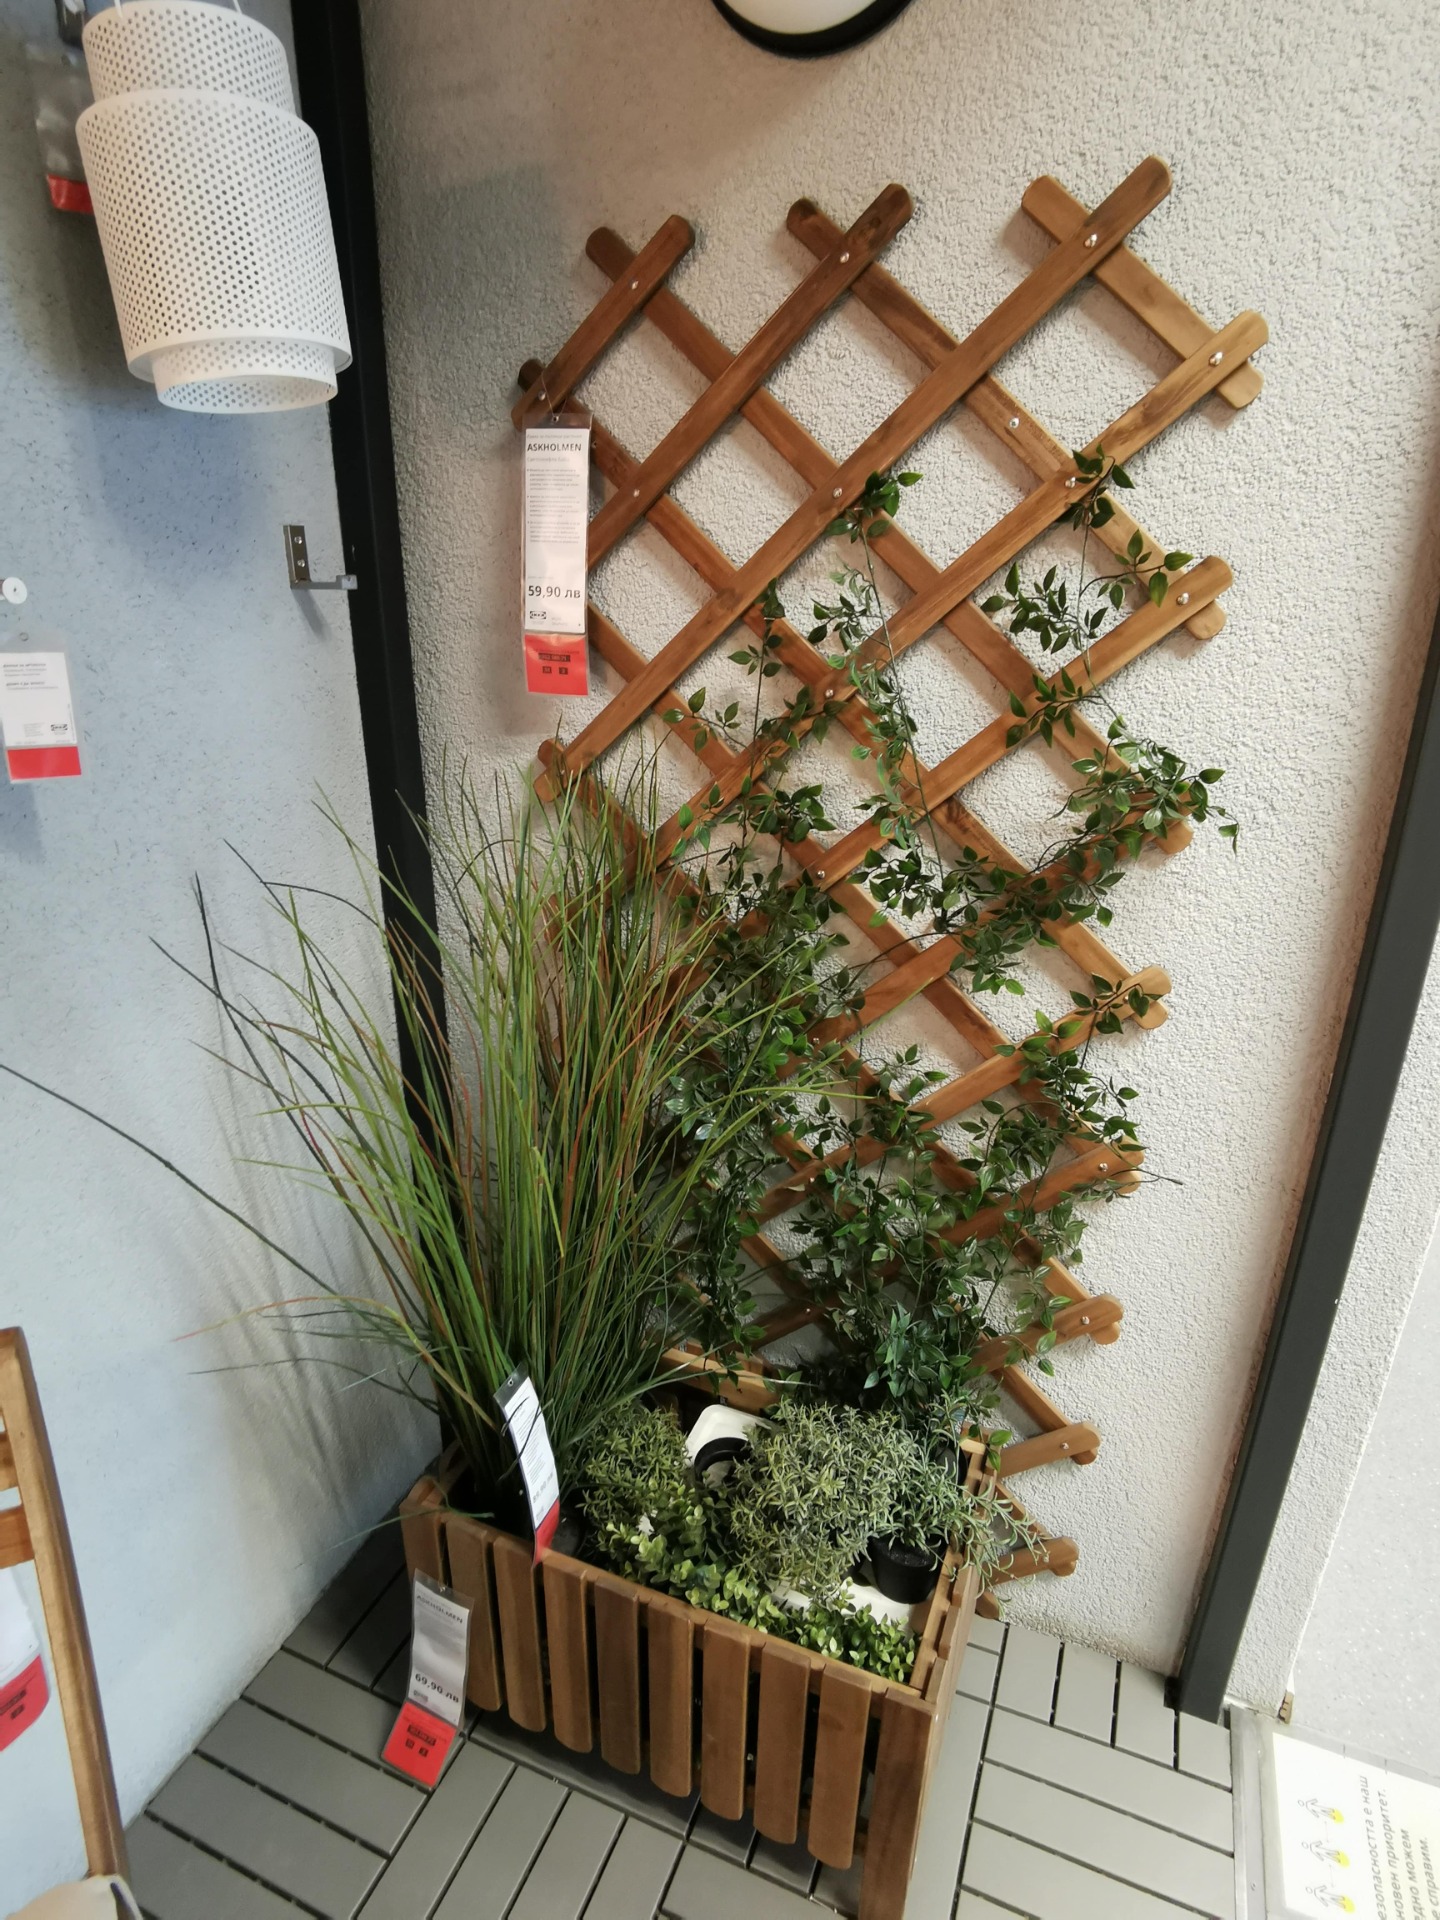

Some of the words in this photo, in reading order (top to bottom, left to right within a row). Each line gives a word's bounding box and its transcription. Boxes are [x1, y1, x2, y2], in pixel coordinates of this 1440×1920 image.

[527, 443, 581, 451] ASKHOLMEN
[528, 585, 561, 598] 59,90
[564, 589, 581, 599] лв
[415, 1673, 443, 1694] 69,90
[1360, 1775, 1371, 1805] наш
[1363, 1807, 1373, 1816] е
[1377, 1788, 1400, 1869] приоритет.
[1400, 1828, 1418, 1884] можем
[1419, 1836, 1440, 1907] справим.
